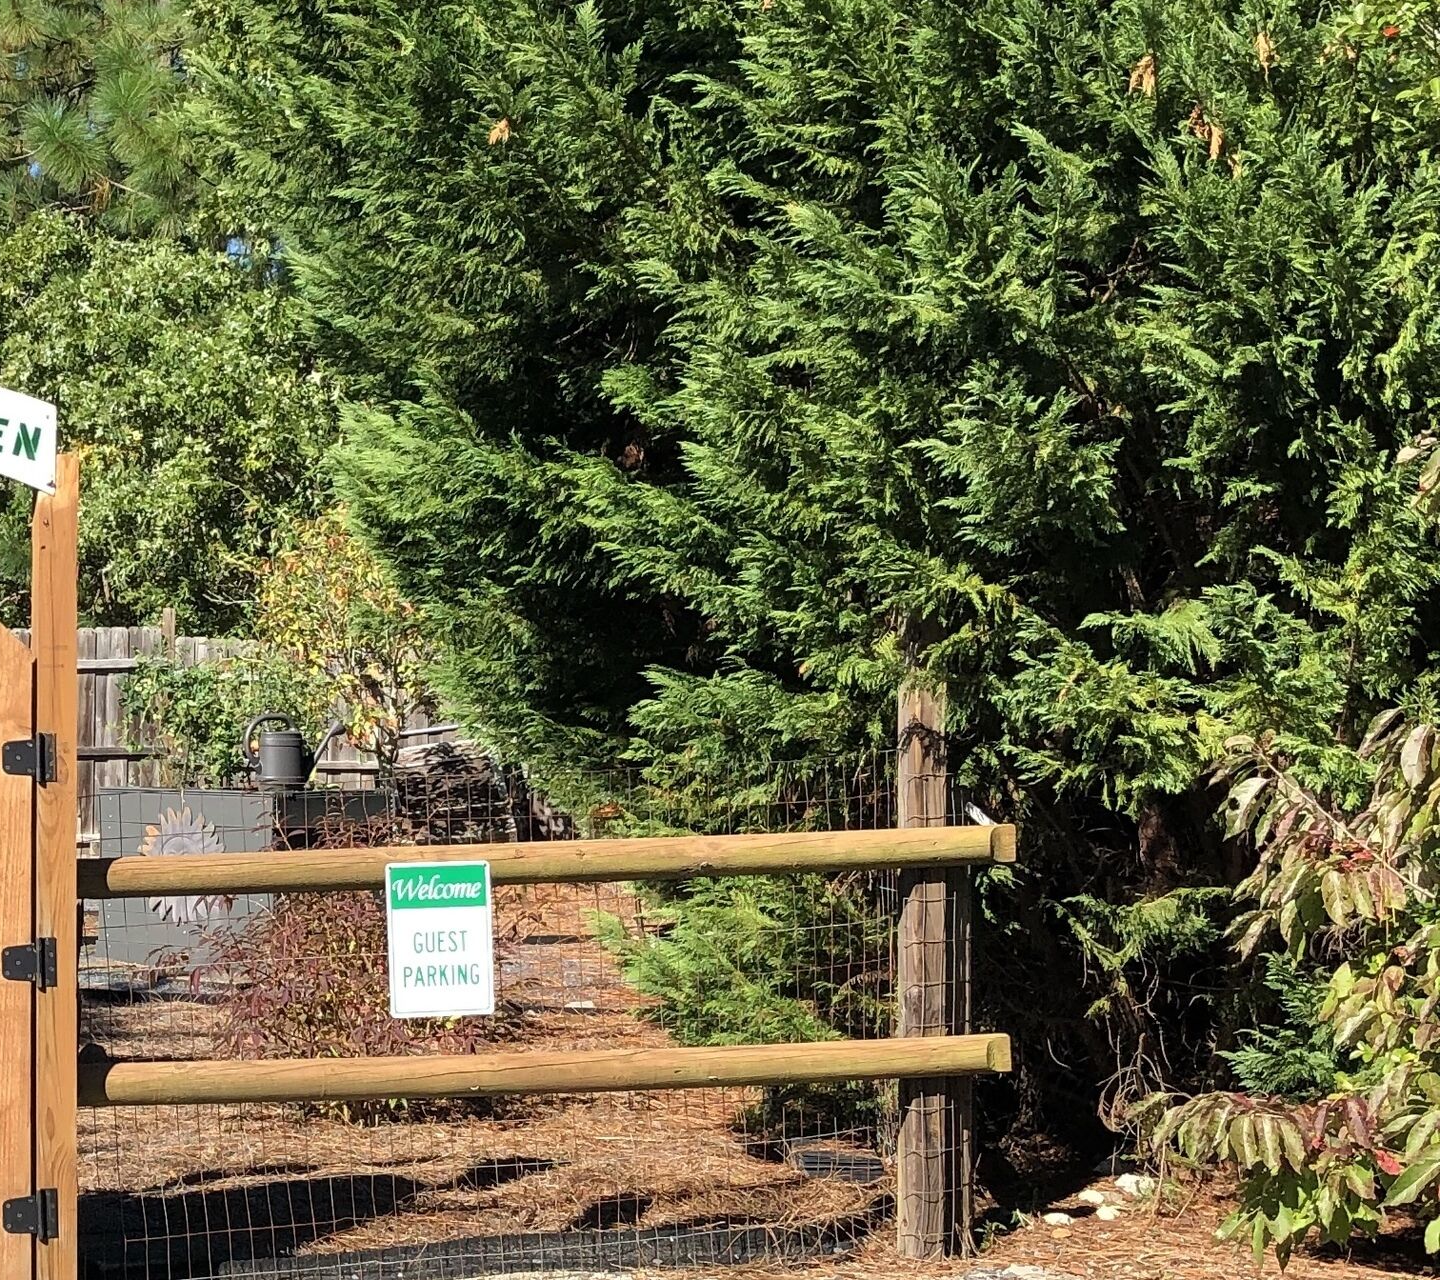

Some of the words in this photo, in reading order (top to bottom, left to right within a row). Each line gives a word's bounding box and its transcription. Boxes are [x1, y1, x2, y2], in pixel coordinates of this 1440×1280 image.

[392, 874, 482, 901] Welcome
[413, 930, 468, 954] GUEST
[403, 963, 480, 988] PARKING
